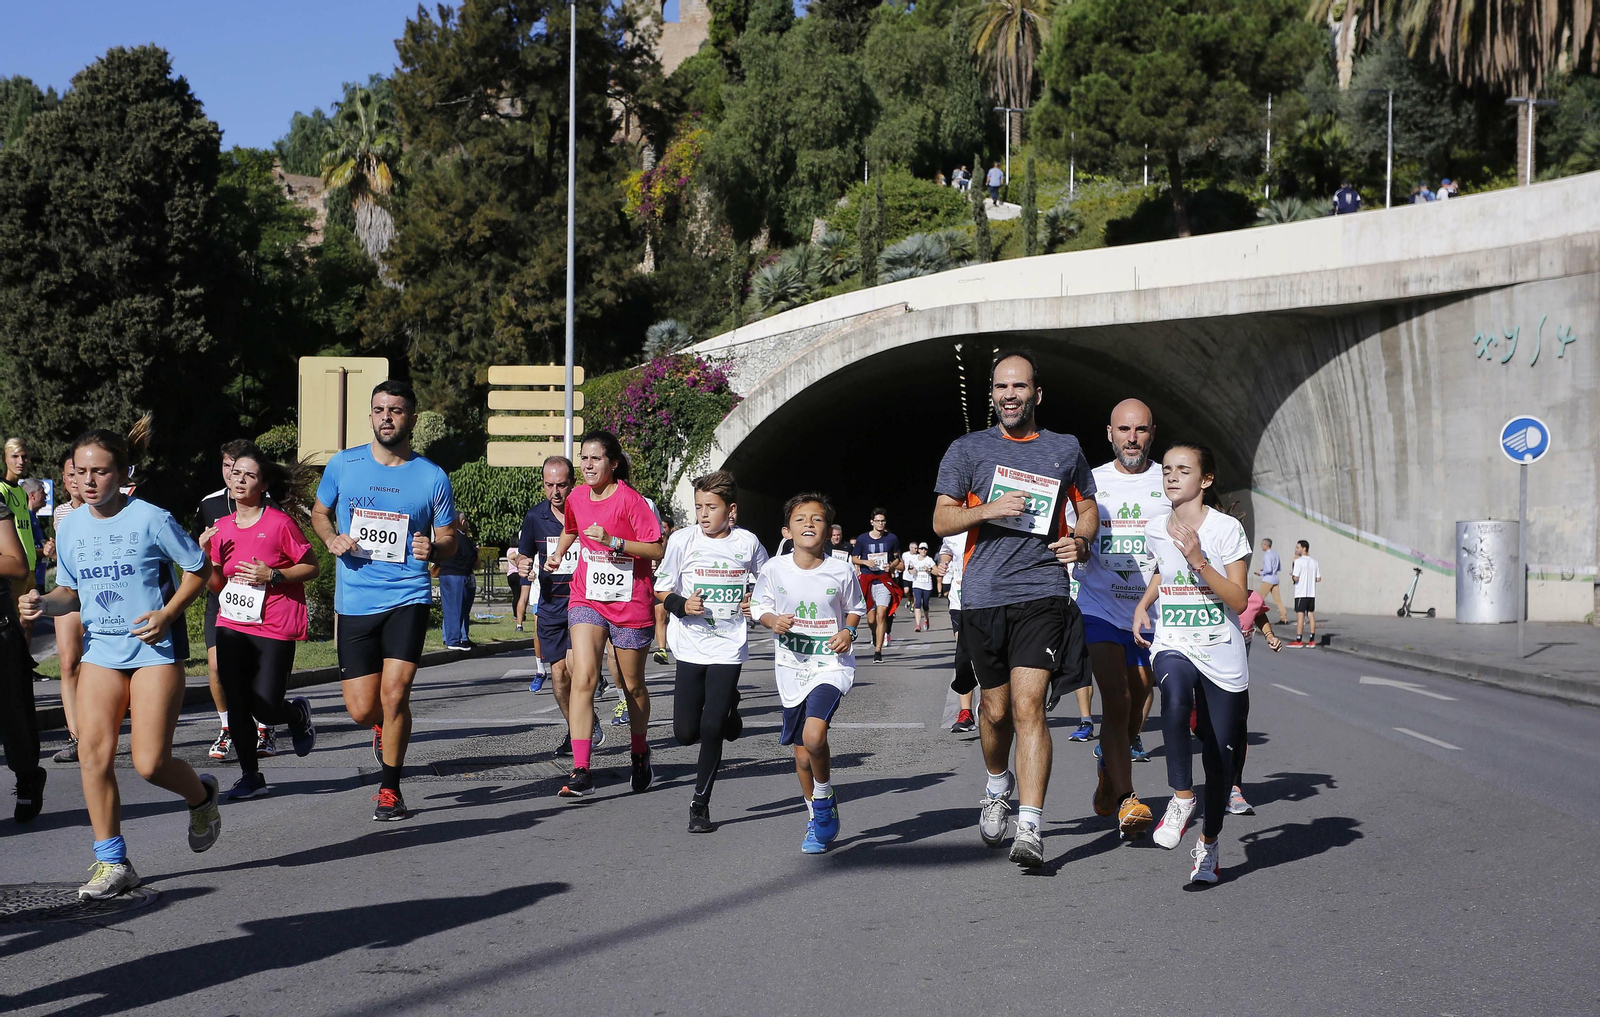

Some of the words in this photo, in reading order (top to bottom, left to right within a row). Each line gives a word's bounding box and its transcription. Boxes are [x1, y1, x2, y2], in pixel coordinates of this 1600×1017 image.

[998, 467, 1008, 477] 41
[1009, 470, 1034, 480] CARRERA
[1036, 476, 1058, 486] URBANA
[348, 497, 375, 508] XXIX
[994, 490, 1048, 516] 242
[355, 509, 362, 517] 41
[360, 528, 397, 544] 9890
[79, 561, 135, 581] nerja
[593, 572, 624, 586] 9892
[90, 582, 128, 590] ATLETISMO
[1160, 587, 1171, 595] 41
[226, 592, 254, 608] 9888
[98, 615, 125, 625] Unicaja
[1164, 608, 1222, 626] 22793
[781, 634, 832, 654] 21778
